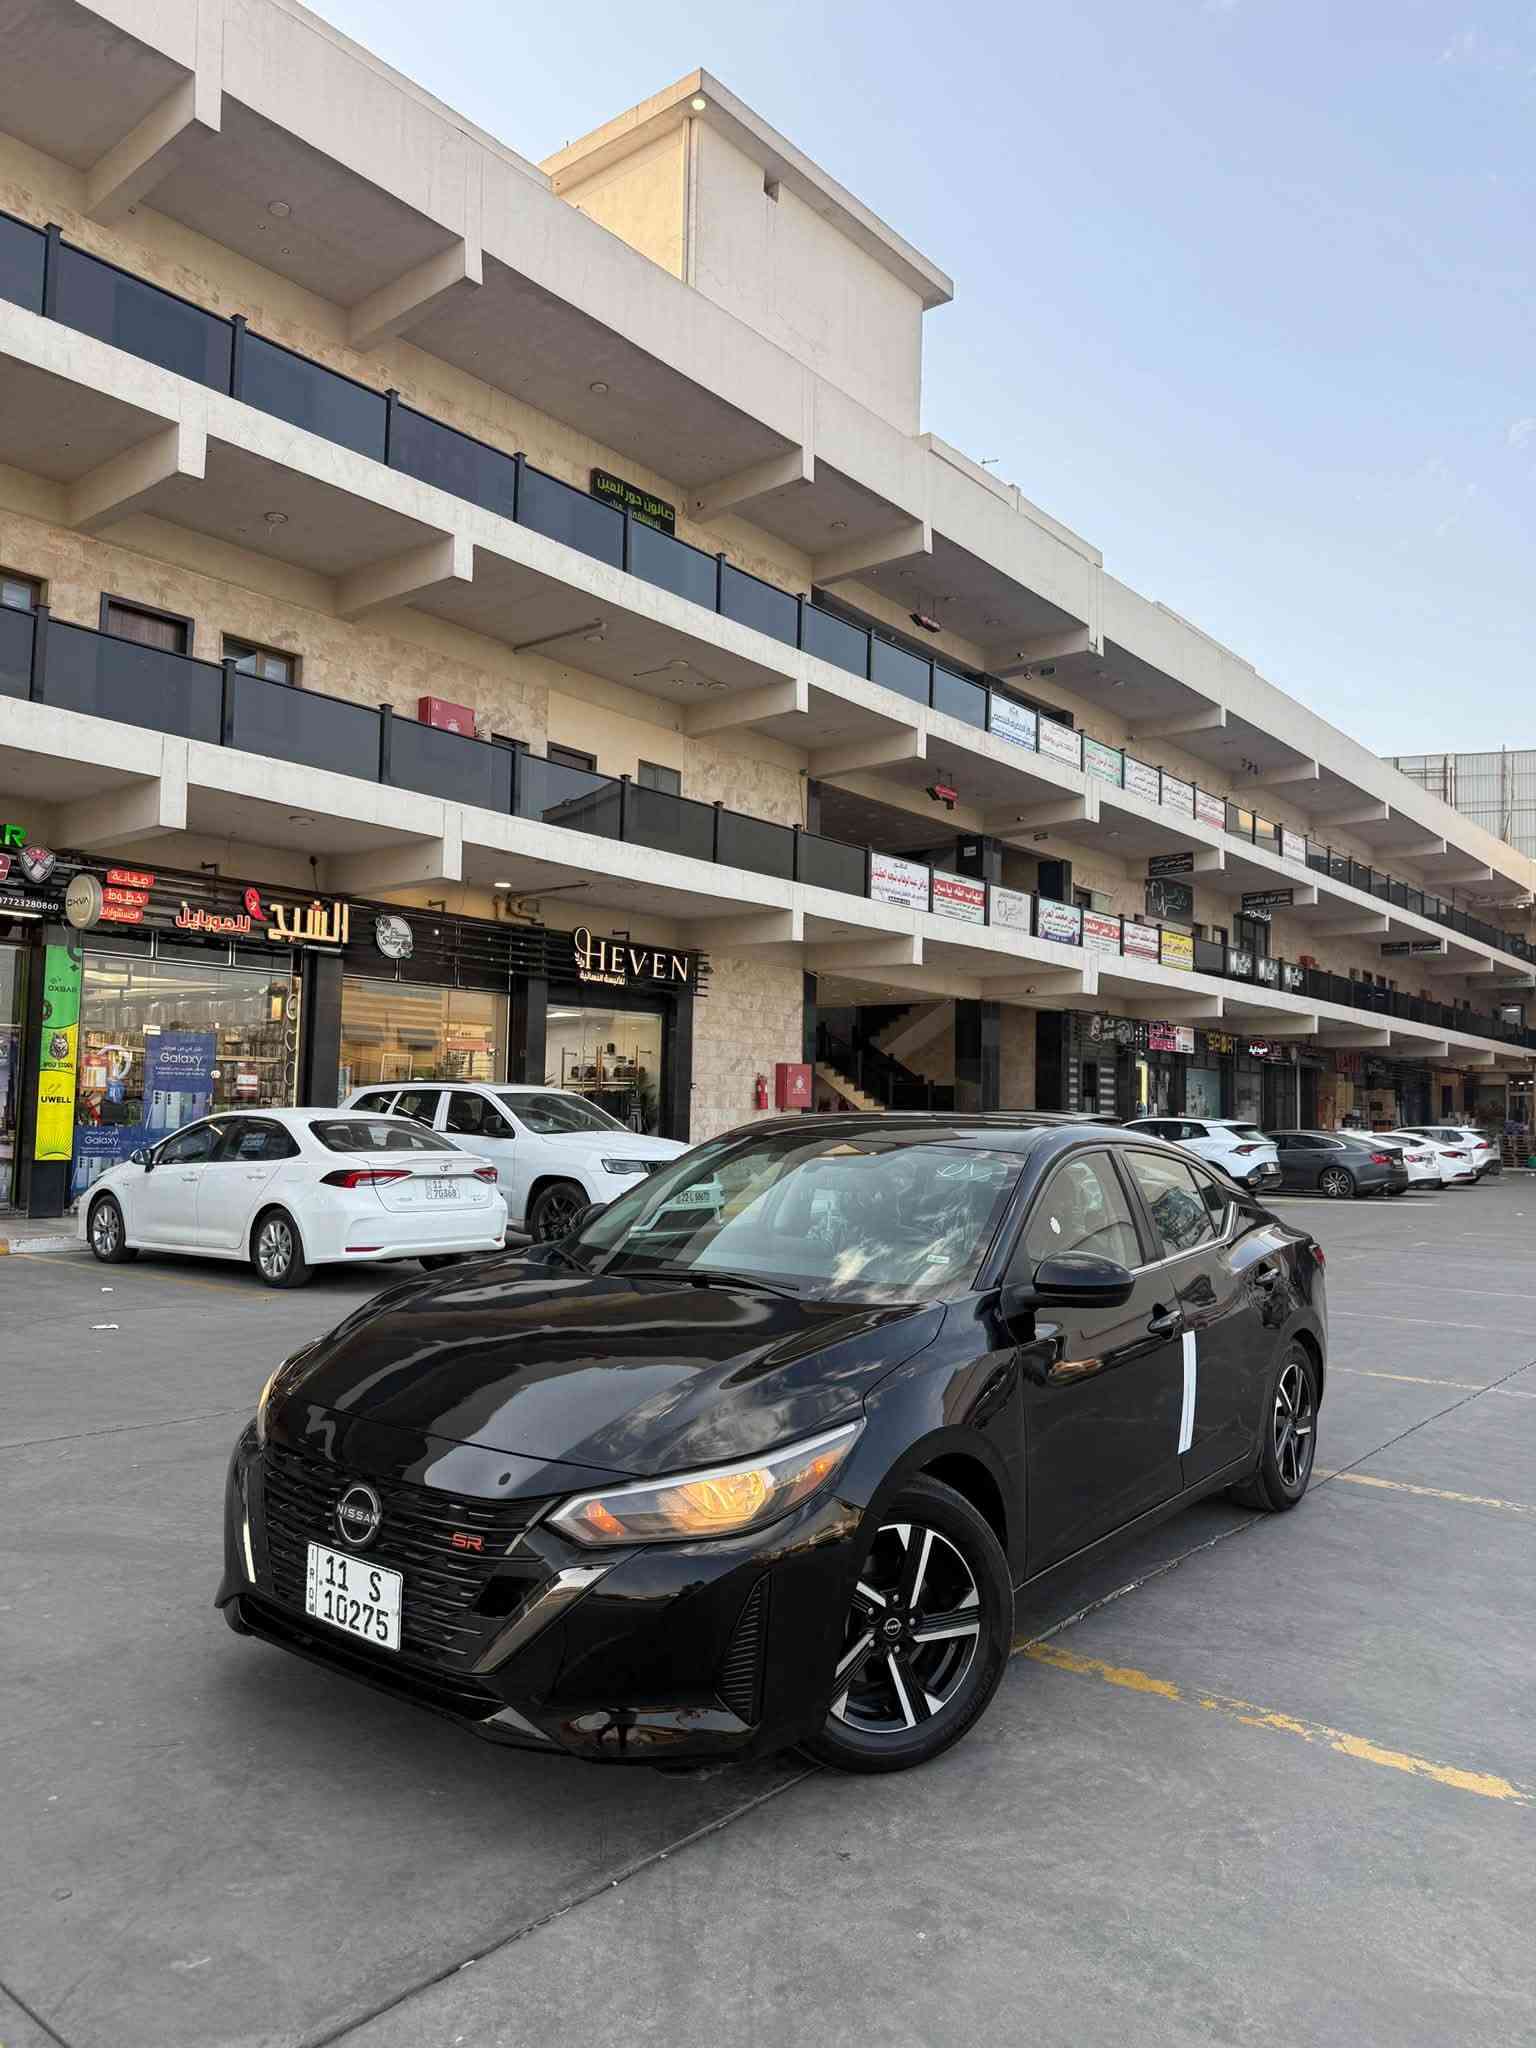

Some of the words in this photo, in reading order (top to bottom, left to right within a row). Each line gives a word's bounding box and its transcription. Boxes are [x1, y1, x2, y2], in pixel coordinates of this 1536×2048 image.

[175, 906, 251, 932] للموبايل
[574, 927, 689, 983] HEVEN
[160, 1052, 202, 1071] Galaxy
[40, 1096, 72, 1104] UWELL
[84, 1135, 120, 1147] Galaxy
[336, 1503, 382, 1526] NISSAN
[452, 1531, 485, 1551] SR
[325, 1555, 349, 1592] 11
[368, 1571, 382, 1603] S
[323, 1590, 390, 1641] 10275
